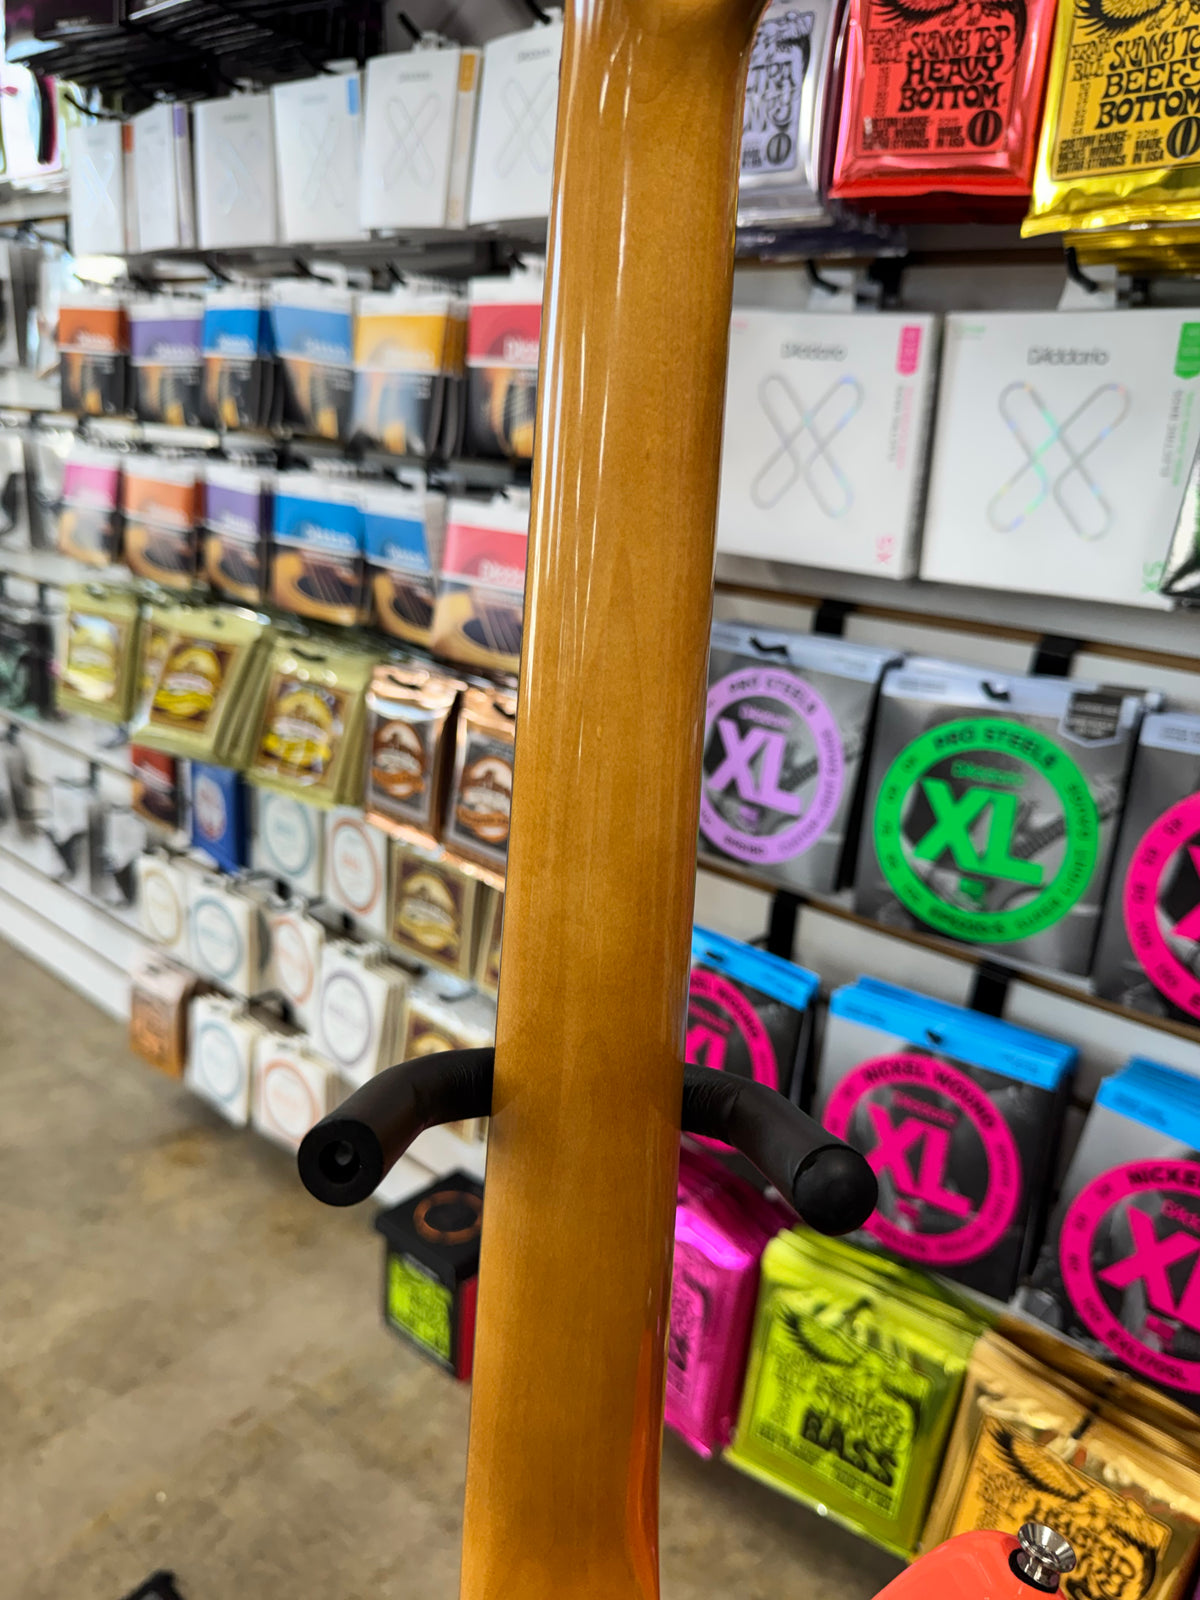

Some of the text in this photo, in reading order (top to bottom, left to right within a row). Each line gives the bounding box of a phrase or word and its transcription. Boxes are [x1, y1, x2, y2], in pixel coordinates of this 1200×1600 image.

[975, 26, 1010, 55] TOP
[1109, 25, 1200, 71] SKINNY TO
[904, 54, 1004, 86] HEAVY
[1103, 57, 1200, 99] BEEFY
[898, 82, 1005, 113] BOTTOM
[1095, 88, 1200, 129] BOTTOM
[706, 715, 801, 817] XL
[931, 726, 1059, 770] PRO STEELS
[913, 775, 1044, 887] XL
[863, 1060, 996, 1131] NICKEL WOUND
[866, 1100, 973, 1219] XL
[1126, 1165, 1200, 1191] NICKE
[801, 1404, 897, 1488] BASS
